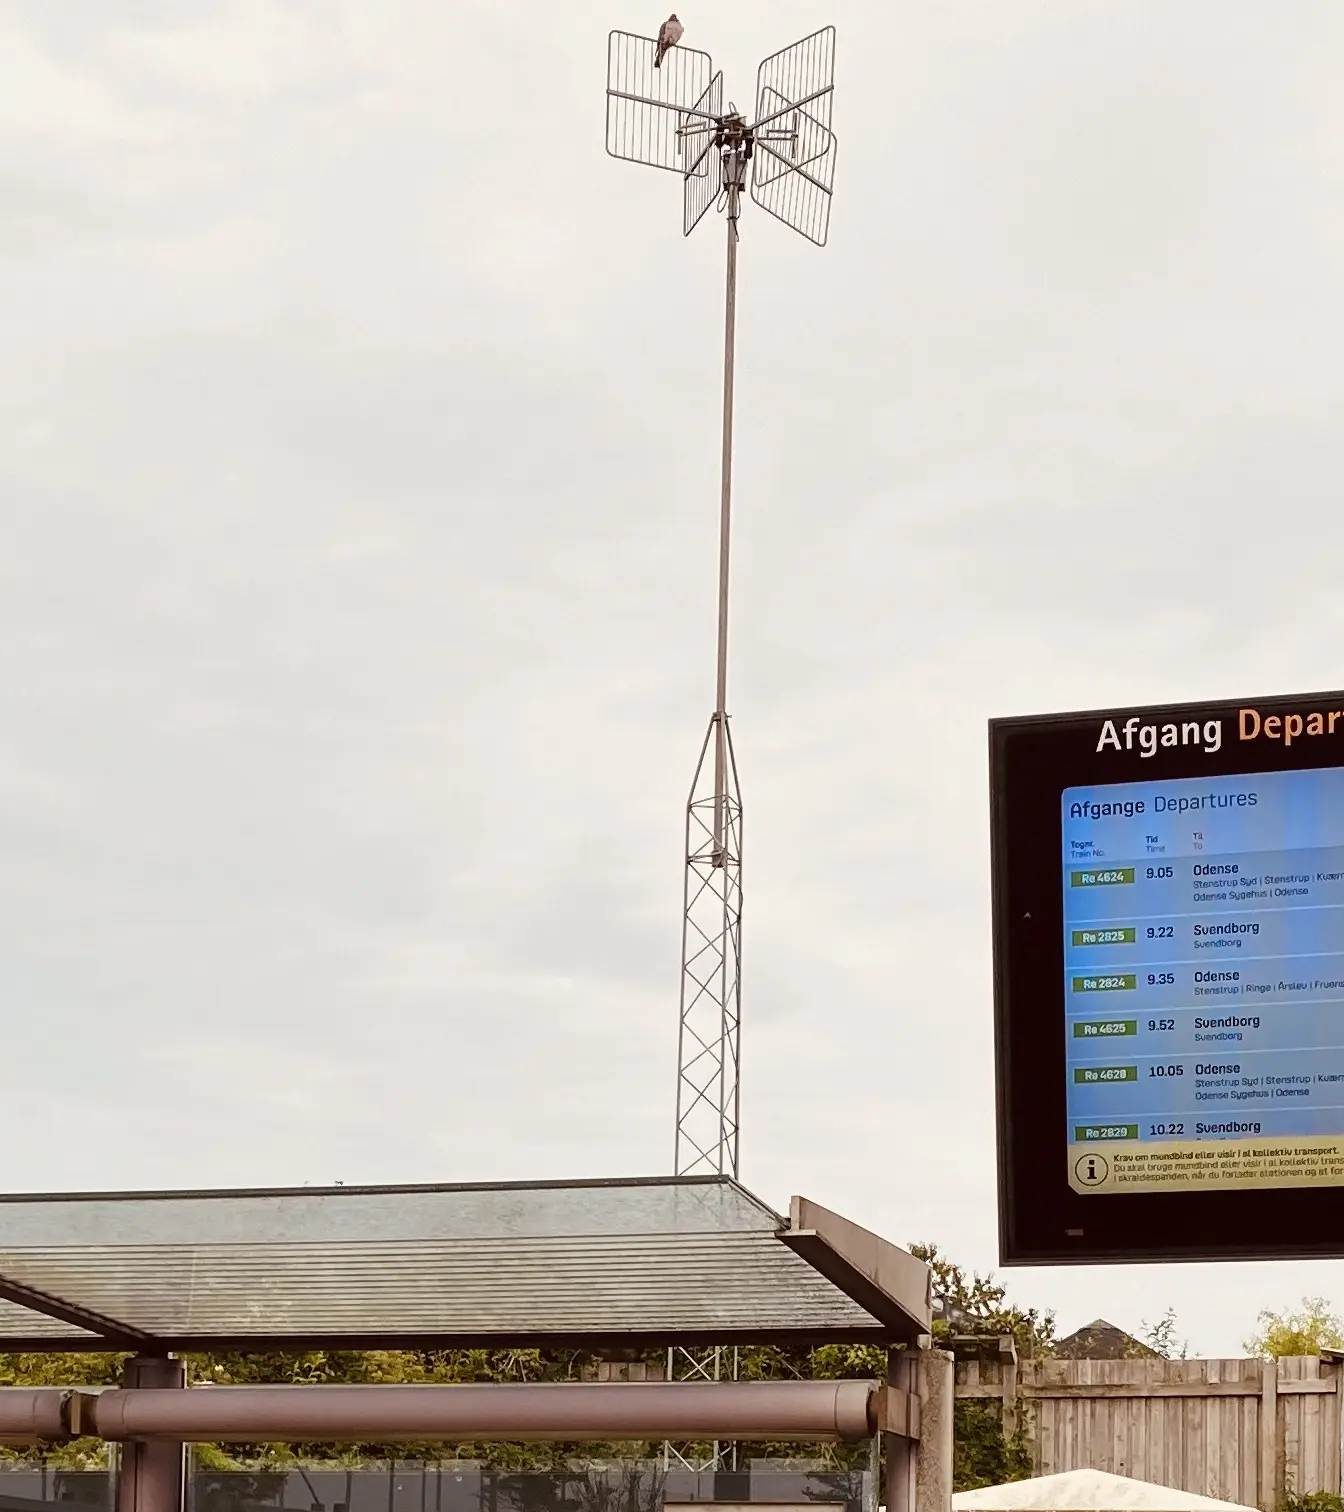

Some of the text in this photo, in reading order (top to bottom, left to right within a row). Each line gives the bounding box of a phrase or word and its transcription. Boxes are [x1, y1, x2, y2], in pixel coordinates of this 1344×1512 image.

[1096, 717, 1222, 758] Afgang
[1070, 792, 1258, 820] Afgange Departures
[1146, 835, 1158, 844] Tid
[1071, 850, 1091, 859] Train
[1146, 844, 1166, 853] Time
[1146, 867, 1174, 879] 9.05
[1193, 864, 1239, 876] Odense
[1097, 871, 1124, 883] 4624
[1193, 879, 1238, 890] Stenstrup
[1240, 877, 1257, 888] Syd
[1264, 874, 1310, 885] Stenstrup
[1193, 887, 1309, 902] Odense Sygehus Odense
[1146, 926, 1174, 939] 9.22
[1194, 922, 1260, 936] Svendborg
[1194, 939, 1242, 949] Svendborg
[1147, 973, 1175, 985] 9.35
[1194, 970, 1240, 982] Odense
[1194, 985, 1239, 996] Stenstrup
[1246, 983, 1271, 993] Ringe
[1148, 1019, 1175, 1031] 9.52
[1194, 1015, 1260, 1029] Svendborg
[1195, 1032, 1243, 1042] Svendborg
[1149, 1065, 1184, 1077] 10.05
[1195, 1063, 1241, 1075] Odense
[1195, 1078, 1240, 1089] Stenstrup
[1242, 1076, 1258, 1087] Syd
[1266, 1074, 1311, 1085] Stenstrup
[1195, 1087, 1310, 1101] Odense Sygehus Odense
[1149, 1123, 1185, 1135] 10.22
[1195, 1121, 1261, 1135] Svendborg
[1113, 1154, 1134, 1162] Krav
[1150, 1151, 1193, 1161] mundbind
[1195, 1151, 1215, 1159] eller
[1217, 1150, 1236, 1158] visir
[1252, 1148, 1292, 1157] kollektiv
[1294, 1146, 1340, 1156] transport.
[1113, 1164, 1125, 1172] Du
[1147, 1162, 1173, 1173] bruge
[1174, 1160, 1219, 1170] mundbind
[1220, 1159, 1241, 1168] eller
[1279, 1156, 1319, 1166] kollektiv
[1191, 1170, 1207, 1179] når
[1209, 1170, 1220, 1179] du
[1221, 1169, 1257, 1179] forlader
[1259, 1168, 1303, 1178] stationen
[1305, 1168, 1317, 1178] og
